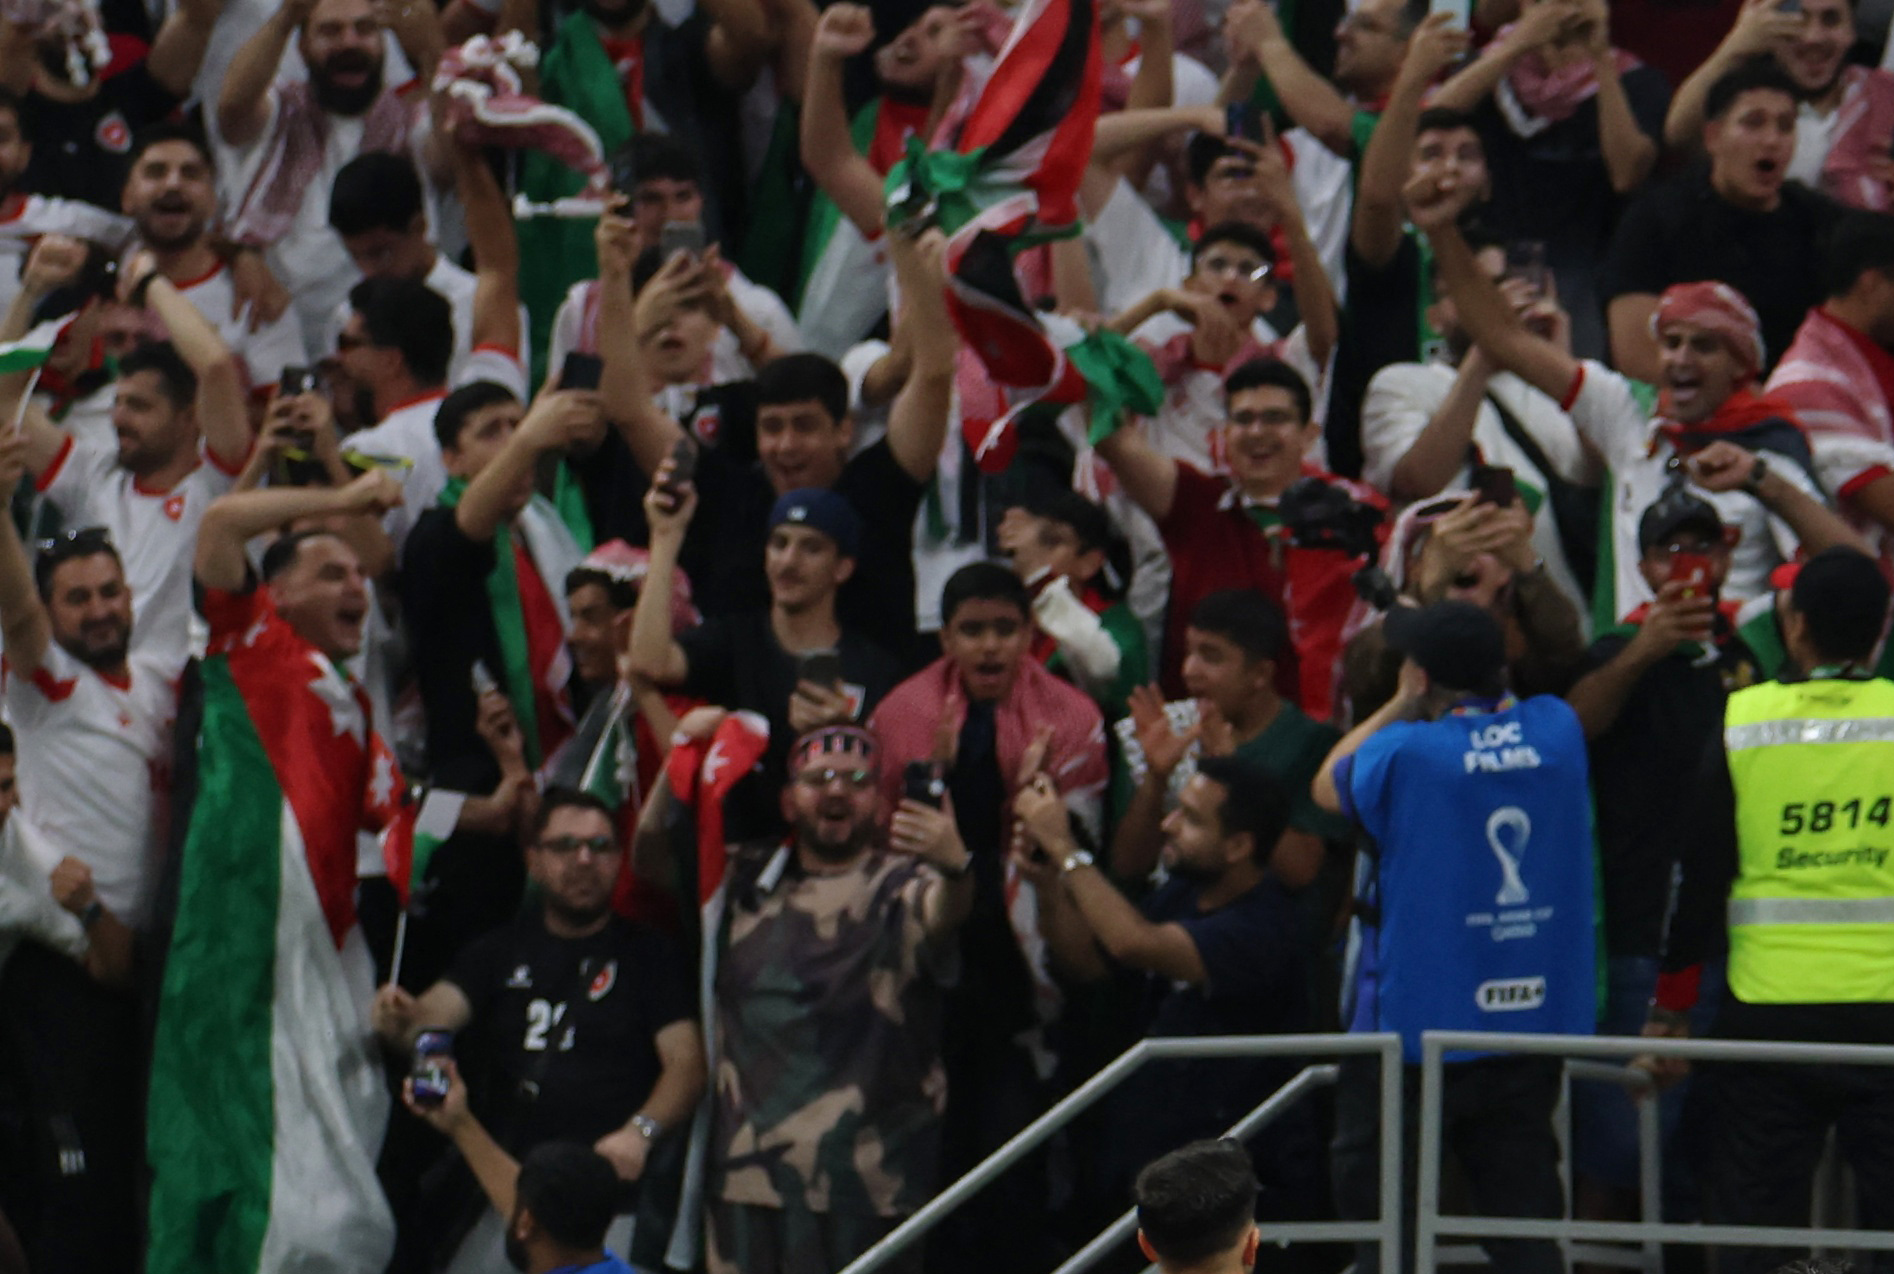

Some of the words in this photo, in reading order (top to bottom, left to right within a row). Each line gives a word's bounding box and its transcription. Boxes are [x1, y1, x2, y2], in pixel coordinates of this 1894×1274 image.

[1470, 721, 1522, 750] LOC
[1780, 797, 1892, 836] 5814
[1776, 846, 1890, 869] Security
